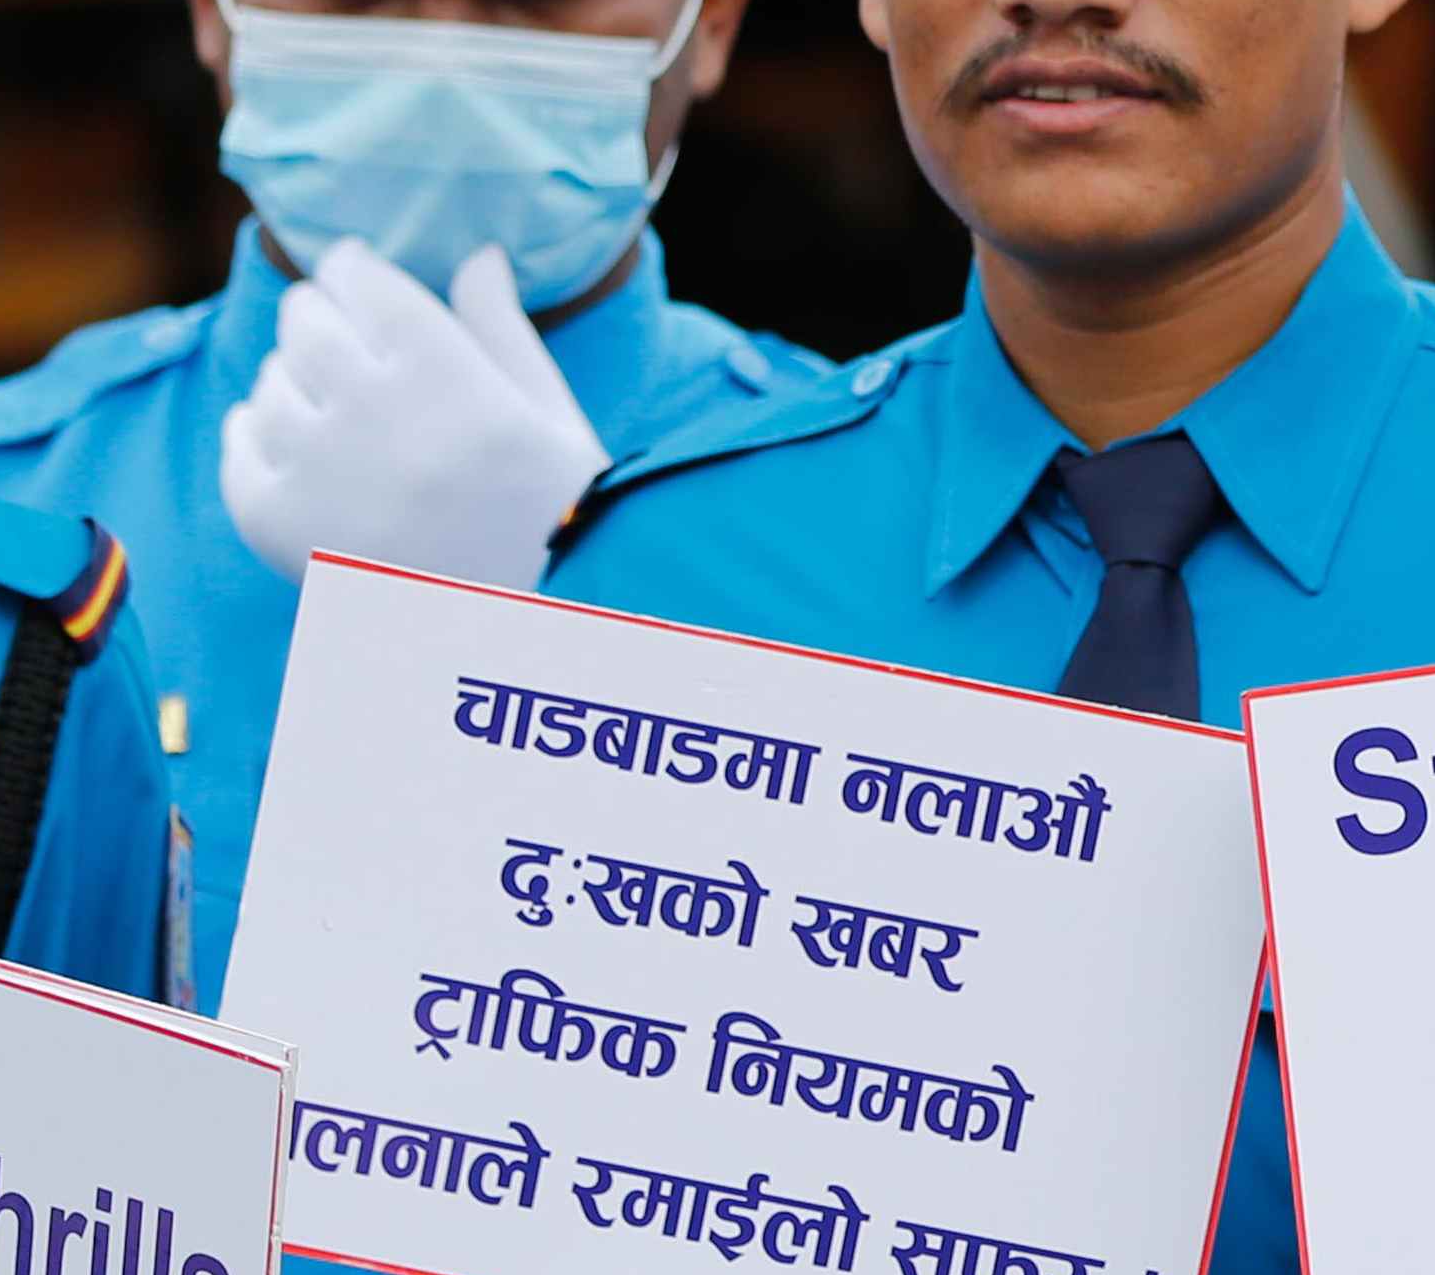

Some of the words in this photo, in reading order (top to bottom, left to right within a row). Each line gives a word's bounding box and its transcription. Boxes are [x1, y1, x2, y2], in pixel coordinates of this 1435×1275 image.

[454, 677, 821, 804] चाडबाडमा
[791, 896, 979, 992] खबर
[414, 969, 687, 1077] ट्राफिक
[706, 1012, 1034, 1152] नियमको
[289, 1101, 551, 1208] ालनाले
[572, 1157, 870, 1272] रमाईलो
